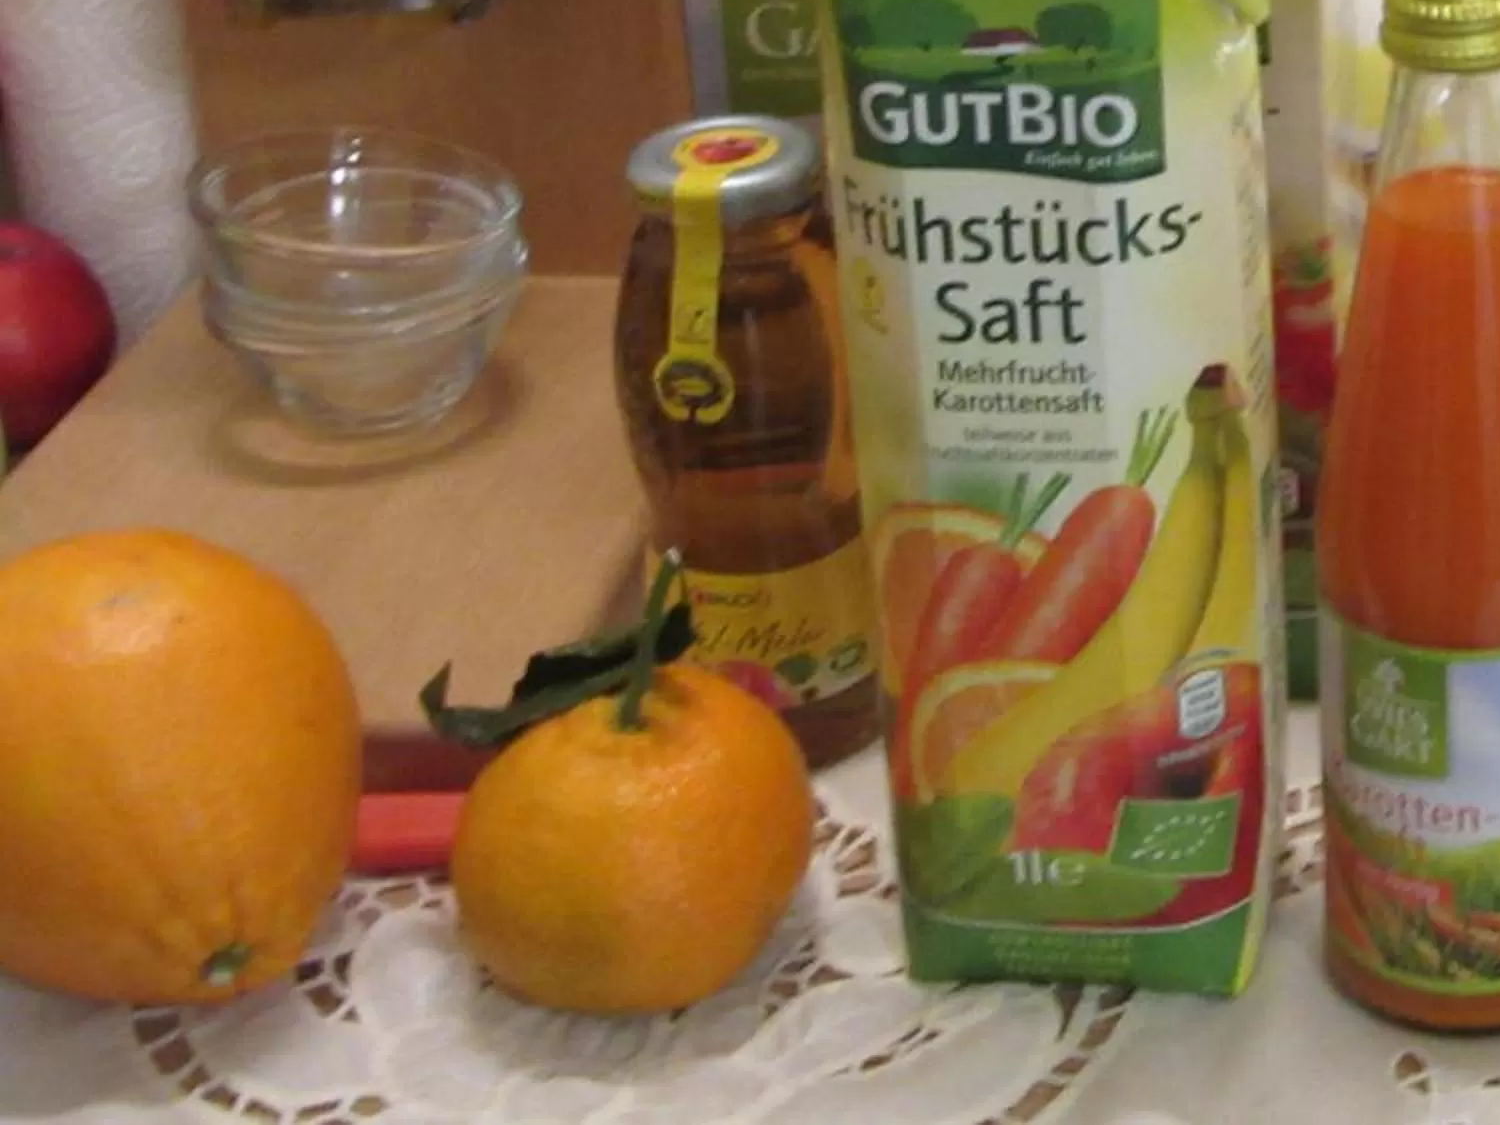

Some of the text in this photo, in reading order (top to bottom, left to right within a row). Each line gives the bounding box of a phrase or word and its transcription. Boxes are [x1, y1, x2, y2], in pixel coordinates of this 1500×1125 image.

[843, 176, 1204, 266] Frühstücks-
[936, 279, 1088, 346] Saft
[938, 359, 1097, 386] Mehrfrucht-
[933, 386, 1105, 415] Karottensaft
